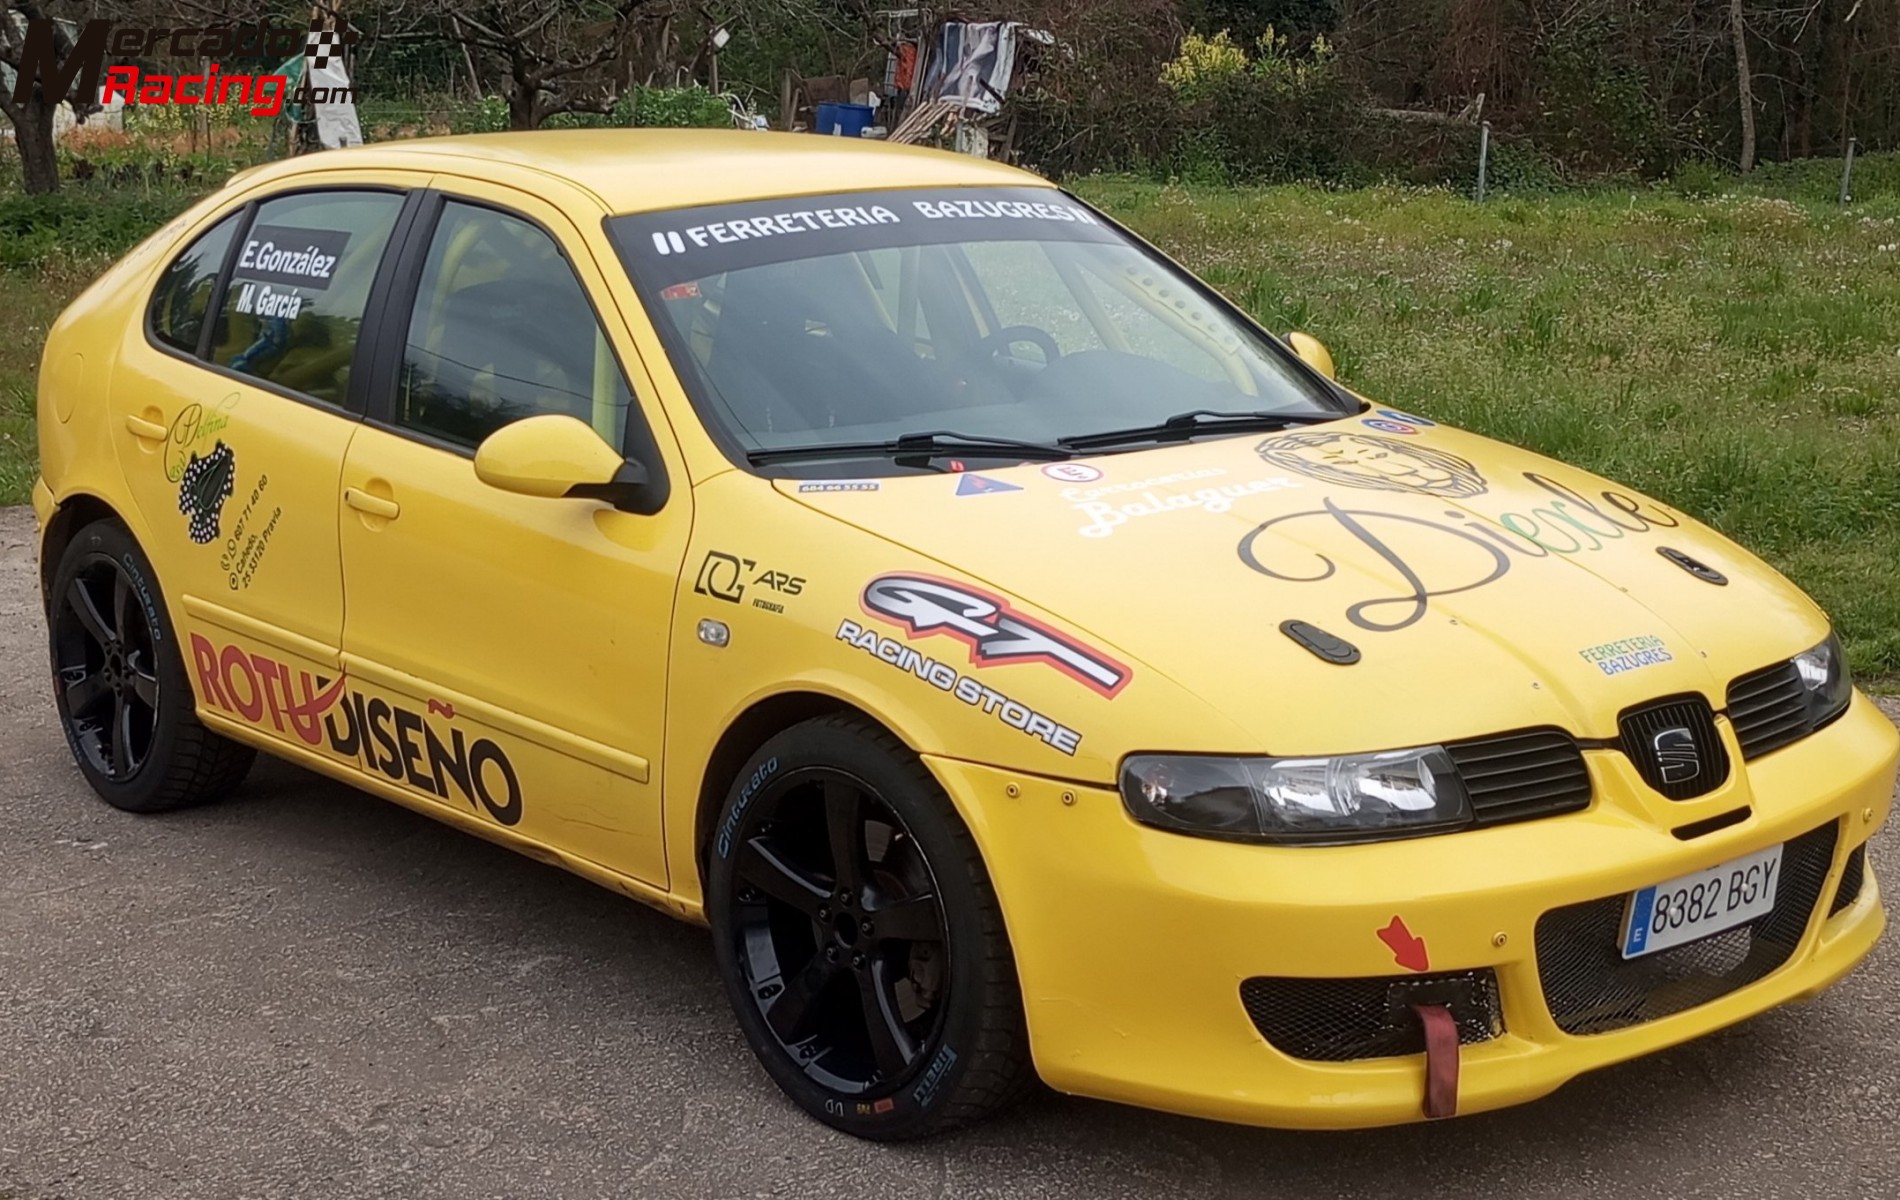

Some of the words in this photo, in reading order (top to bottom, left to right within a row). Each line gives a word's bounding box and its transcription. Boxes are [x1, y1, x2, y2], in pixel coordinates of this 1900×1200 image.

[686, 205, 901, 248] FERRETERIA
[912, 200, 1076, 222] BAZUGRES
[236, 283, 256, 314] M.
[255, 286, 302, 320] García
[262, 506, 282, 543] Pravia
[1071, 475, 1305, 539] Balaguer
[752, 569, 807, 596] ARS
[1578, 634, 1665, 664] FERRETERIA
[1597, 647, 1673, 676] BAZUGRES
[835, 618, 956, 692] RACING
[953, 675, 1083, 758] STORE
[717, 757, 779, 860] Cinturato
[1633, 926, 1644, 943] E
[1651, 877, 1722, 935] 8382
[1726, 857, 1777, 912] BGY
